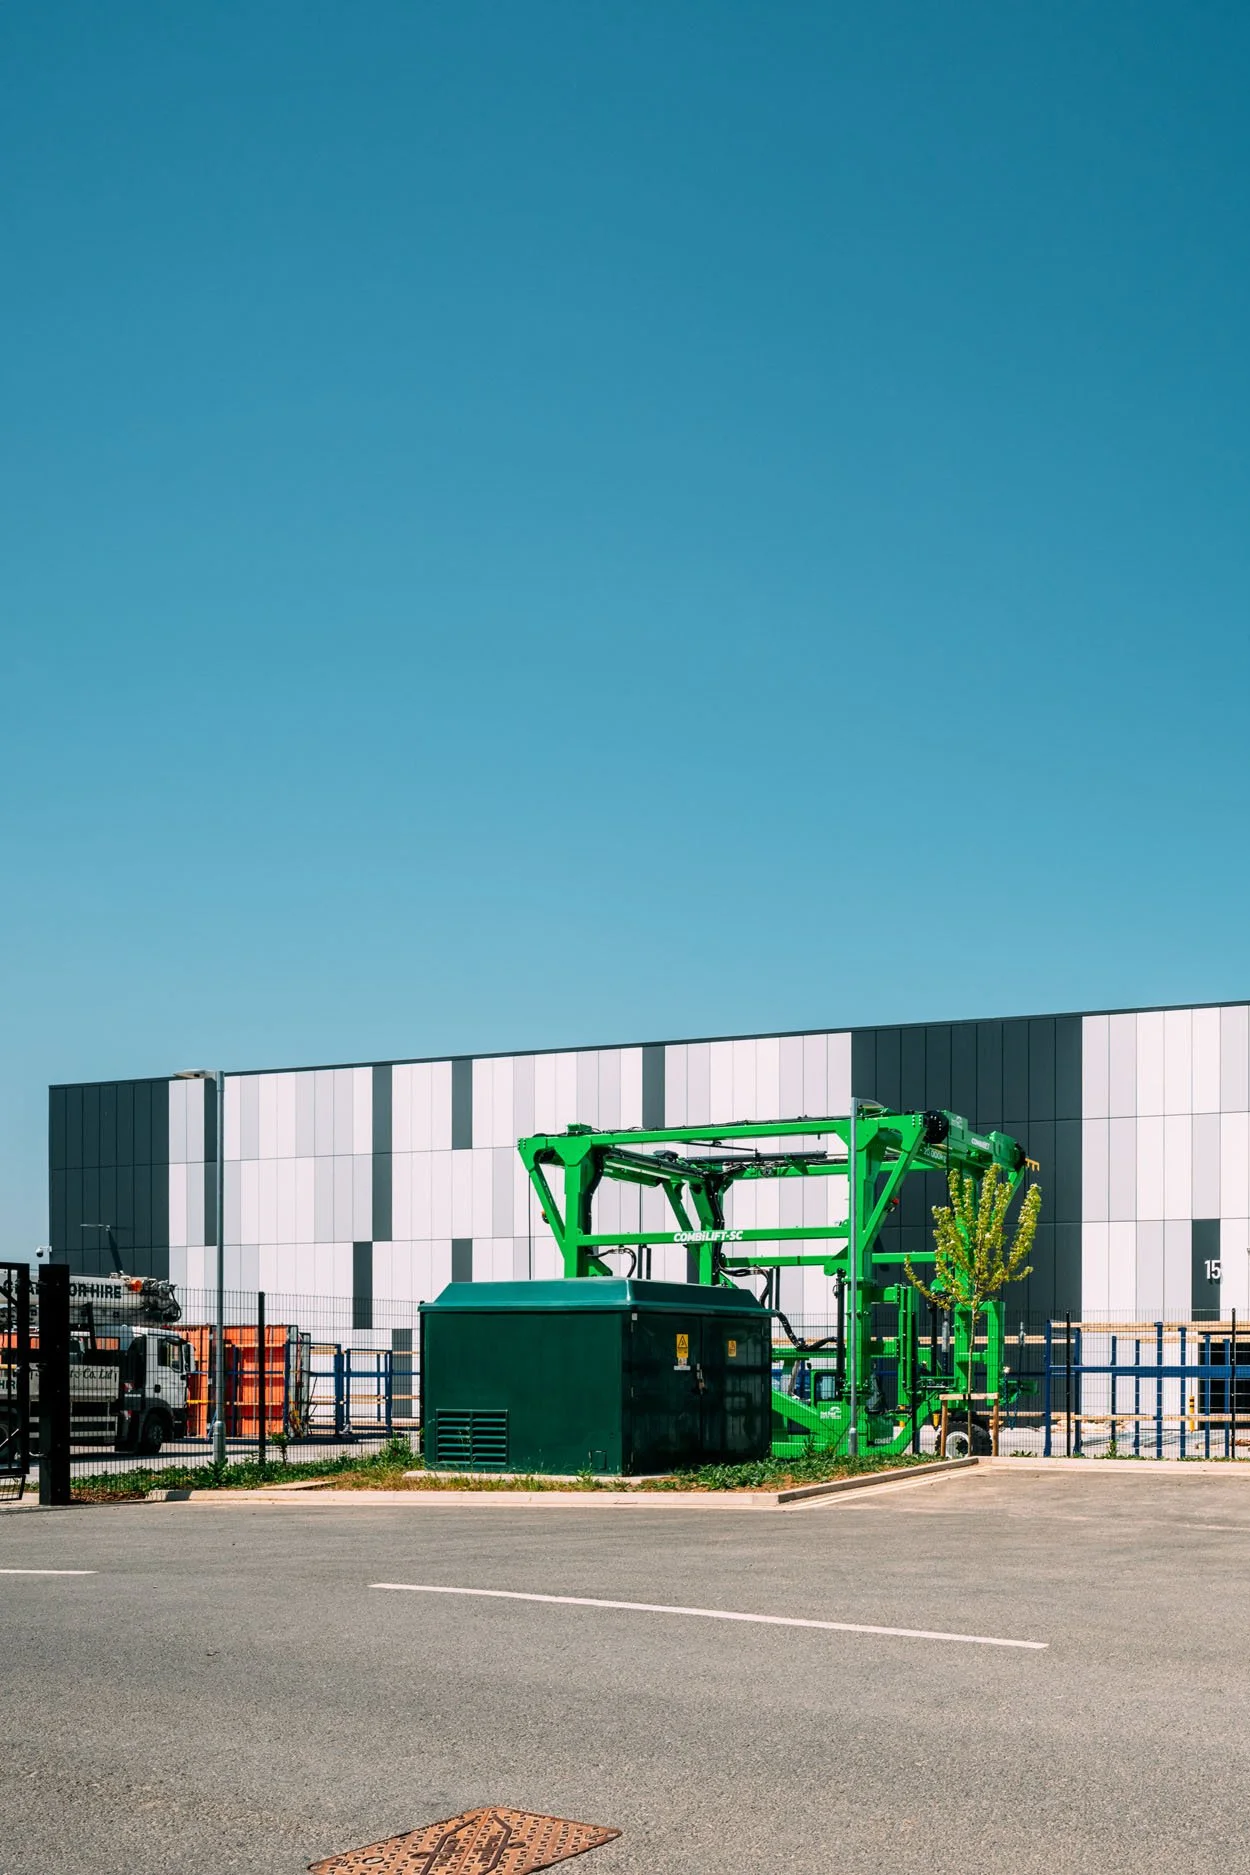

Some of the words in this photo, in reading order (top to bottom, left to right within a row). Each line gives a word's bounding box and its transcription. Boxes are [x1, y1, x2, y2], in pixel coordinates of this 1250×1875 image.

[674, 1230, 743, 1242] COMBILIFT-SC
[1204, 1259, 1221, 1280] 15
[69, 1283, 87, 1298] OR
[90, 1284, 122, 1299] HIRE
